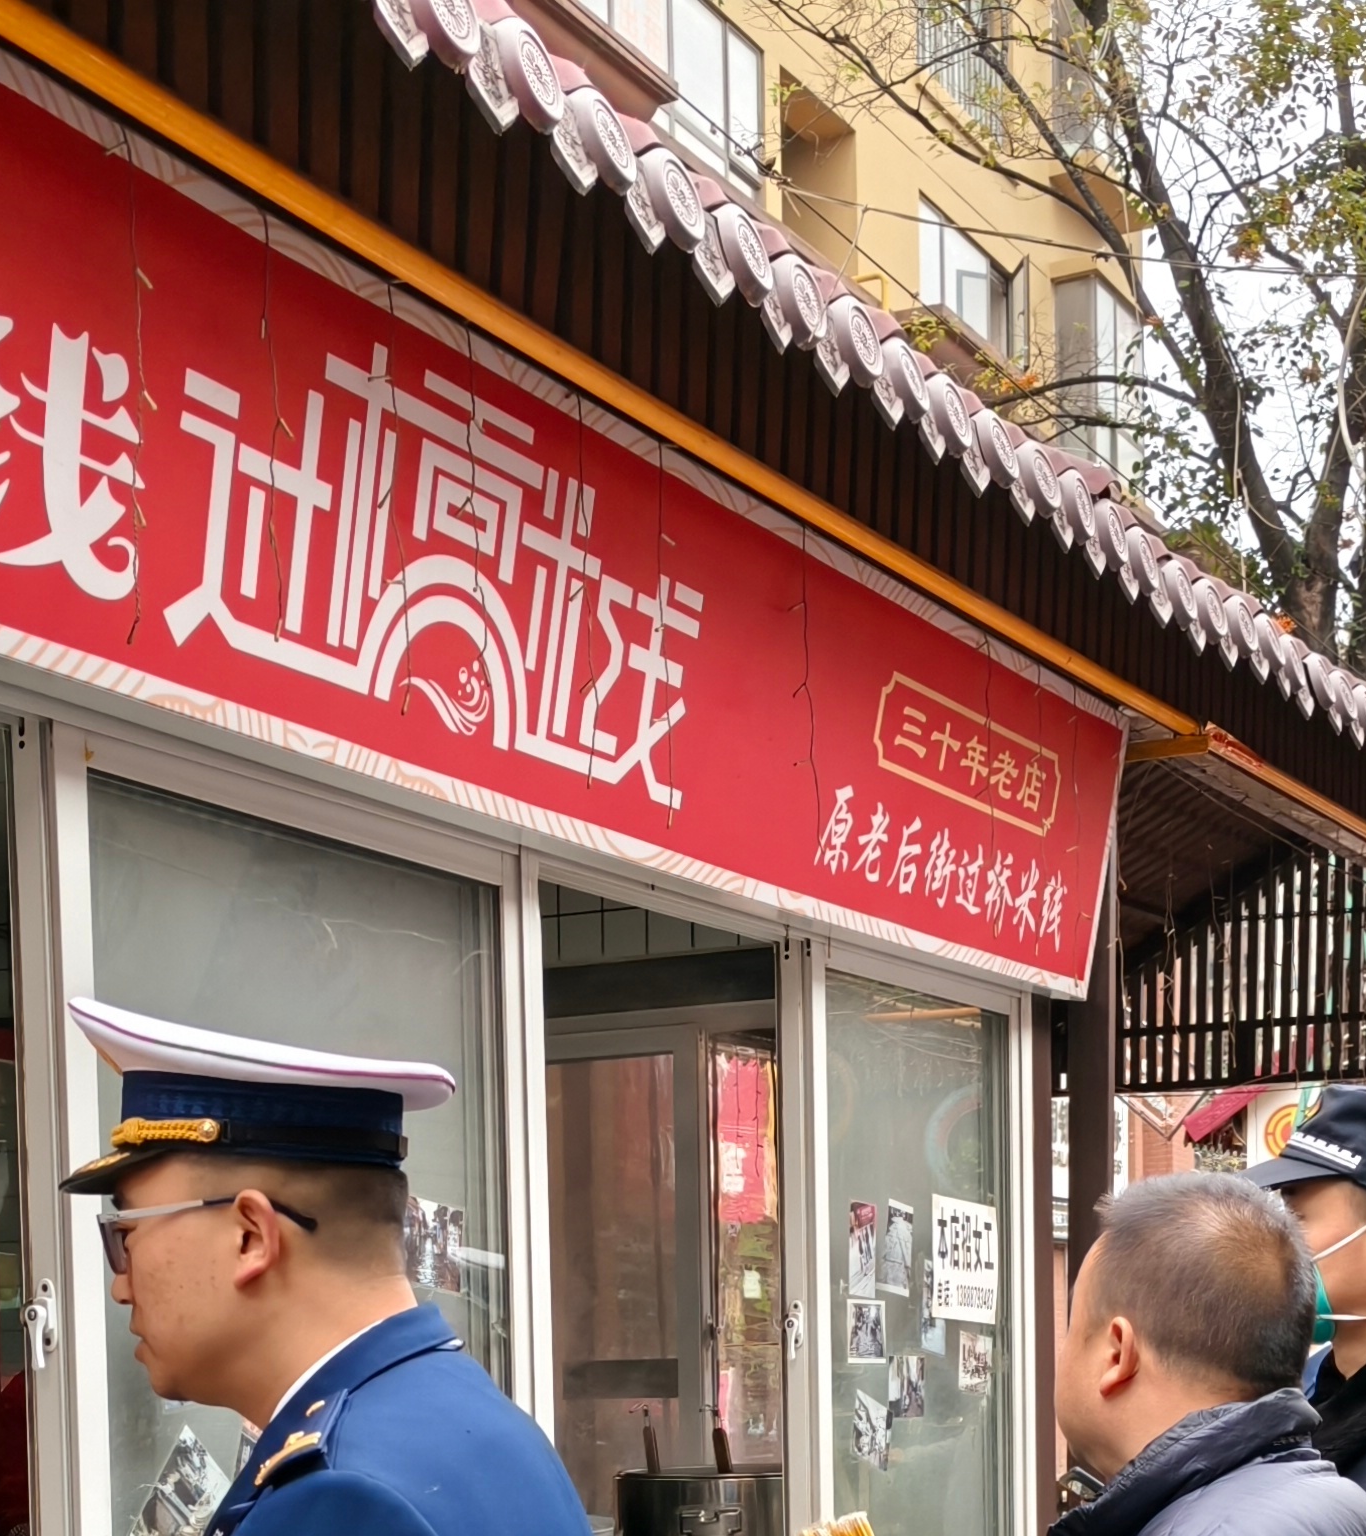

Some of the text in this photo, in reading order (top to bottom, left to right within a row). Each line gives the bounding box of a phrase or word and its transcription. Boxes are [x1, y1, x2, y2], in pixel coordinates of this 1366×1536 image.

[894, 706, 1047, 813] 三十年老店
[813, 784, 1068, 953] 原老后街过桥米线
[937, 1206, 995, 1273] 本店招女工
